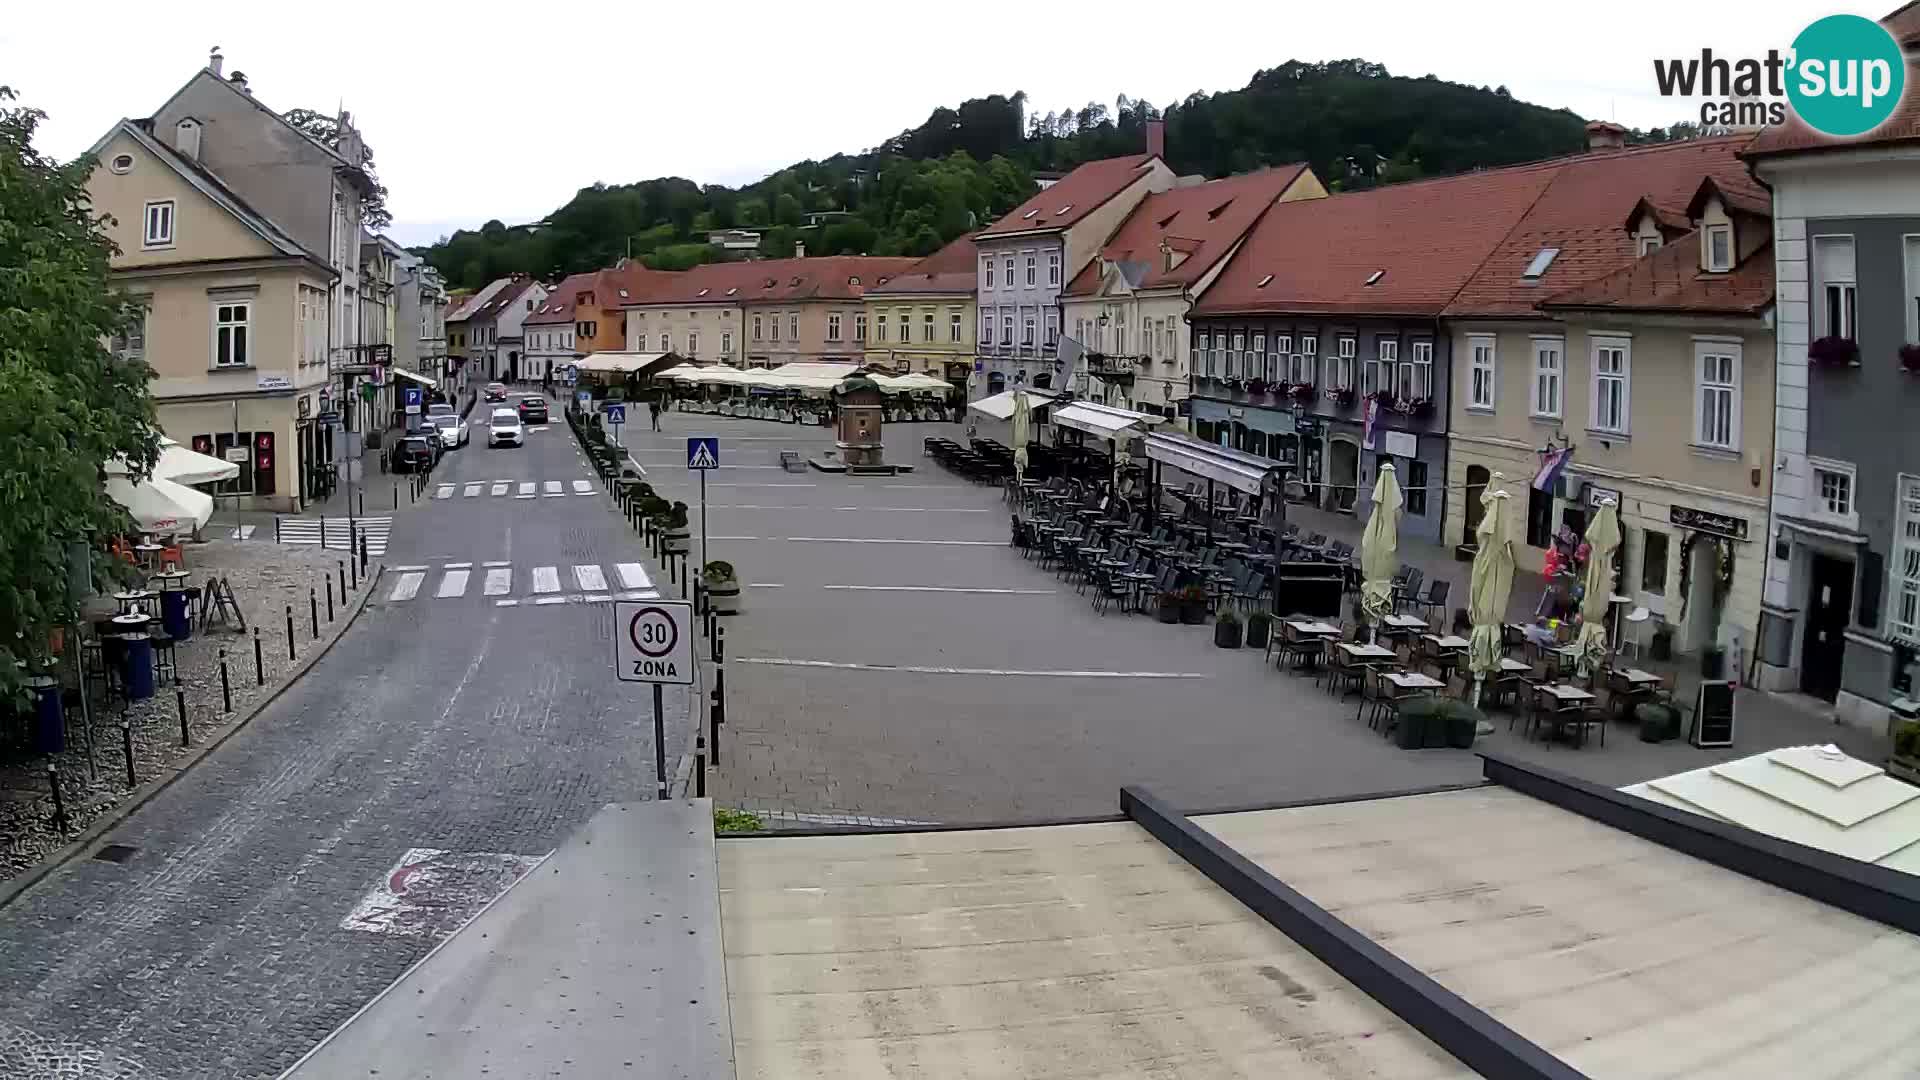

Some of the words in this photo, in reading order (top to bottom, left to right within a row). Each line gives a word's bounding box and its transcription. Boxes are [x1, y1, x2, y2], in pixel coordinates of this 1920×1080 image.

[409, 391, 417, 403] P
[642, 622, 667, 644] 30
[632, 660, 677, 677] ZONA
